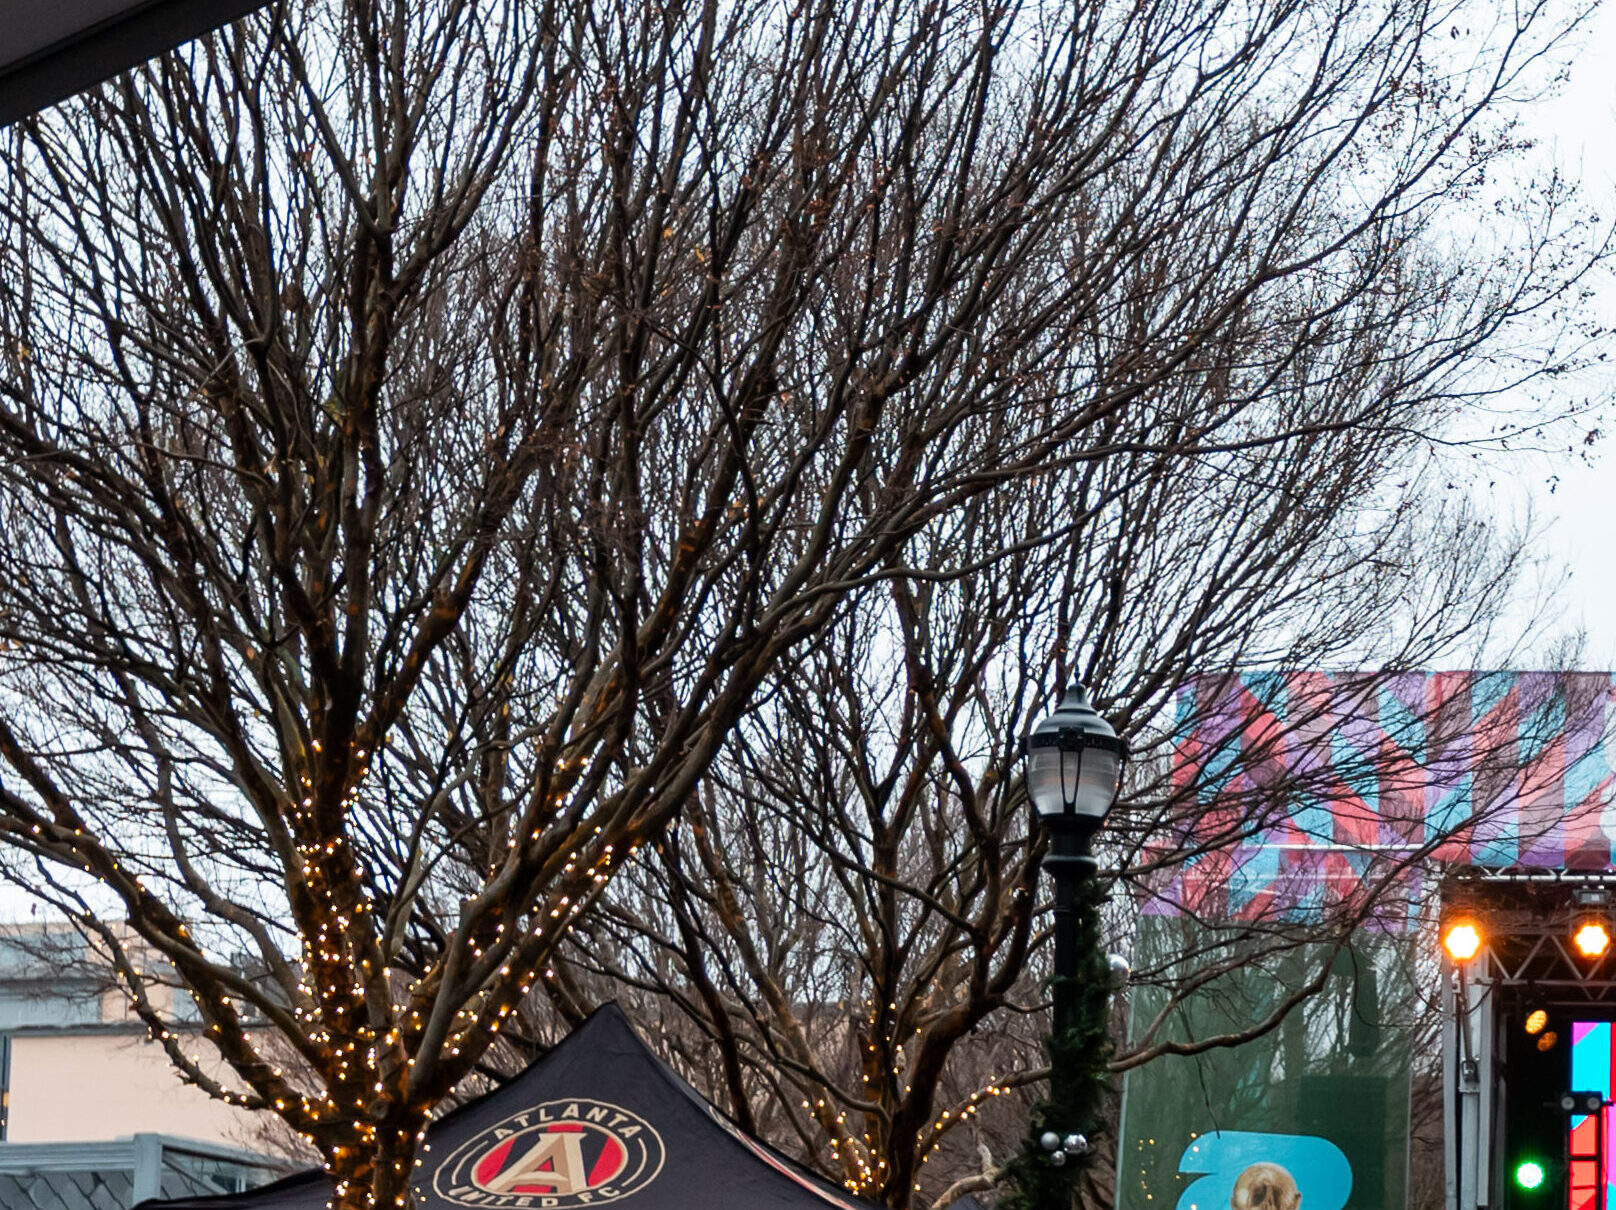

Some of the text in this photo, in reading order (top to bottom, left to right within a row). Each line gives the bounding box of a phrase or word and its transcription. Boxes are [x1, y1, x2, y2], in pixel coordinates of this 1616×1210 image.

[493, 1102, 642, 1140] ATLANTA
[447, 1183, 622, 1207] UNITED FC
